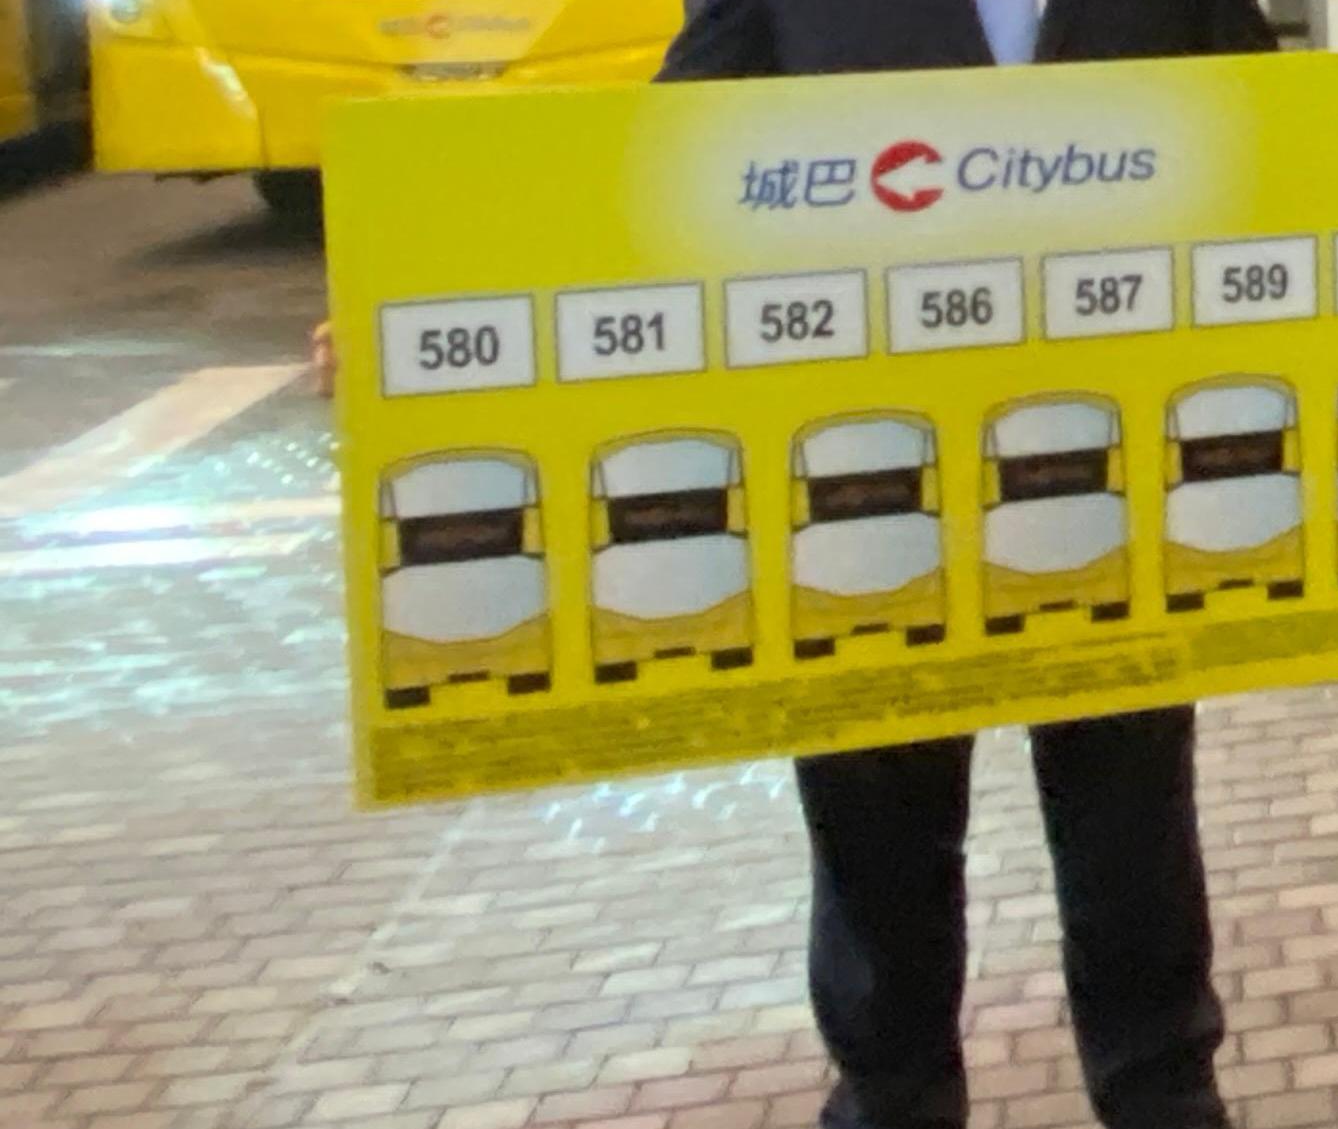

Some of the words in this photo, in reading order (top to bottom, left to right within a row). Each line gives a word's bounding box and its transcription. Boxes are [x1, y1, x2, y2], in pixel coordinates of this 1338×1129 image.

[737, 156, 858, 211] 城巴
[957, 144, 1158, 193] Citybus
[1074, 274, 1144, 317] 587
[1221, 262, 1290, 303] 589
[758, 299, 836, 344] 582
[920, 286, 994, 330] 586
[418, 325, 501, 370] 580
[592, 312, 666, 357] 581
